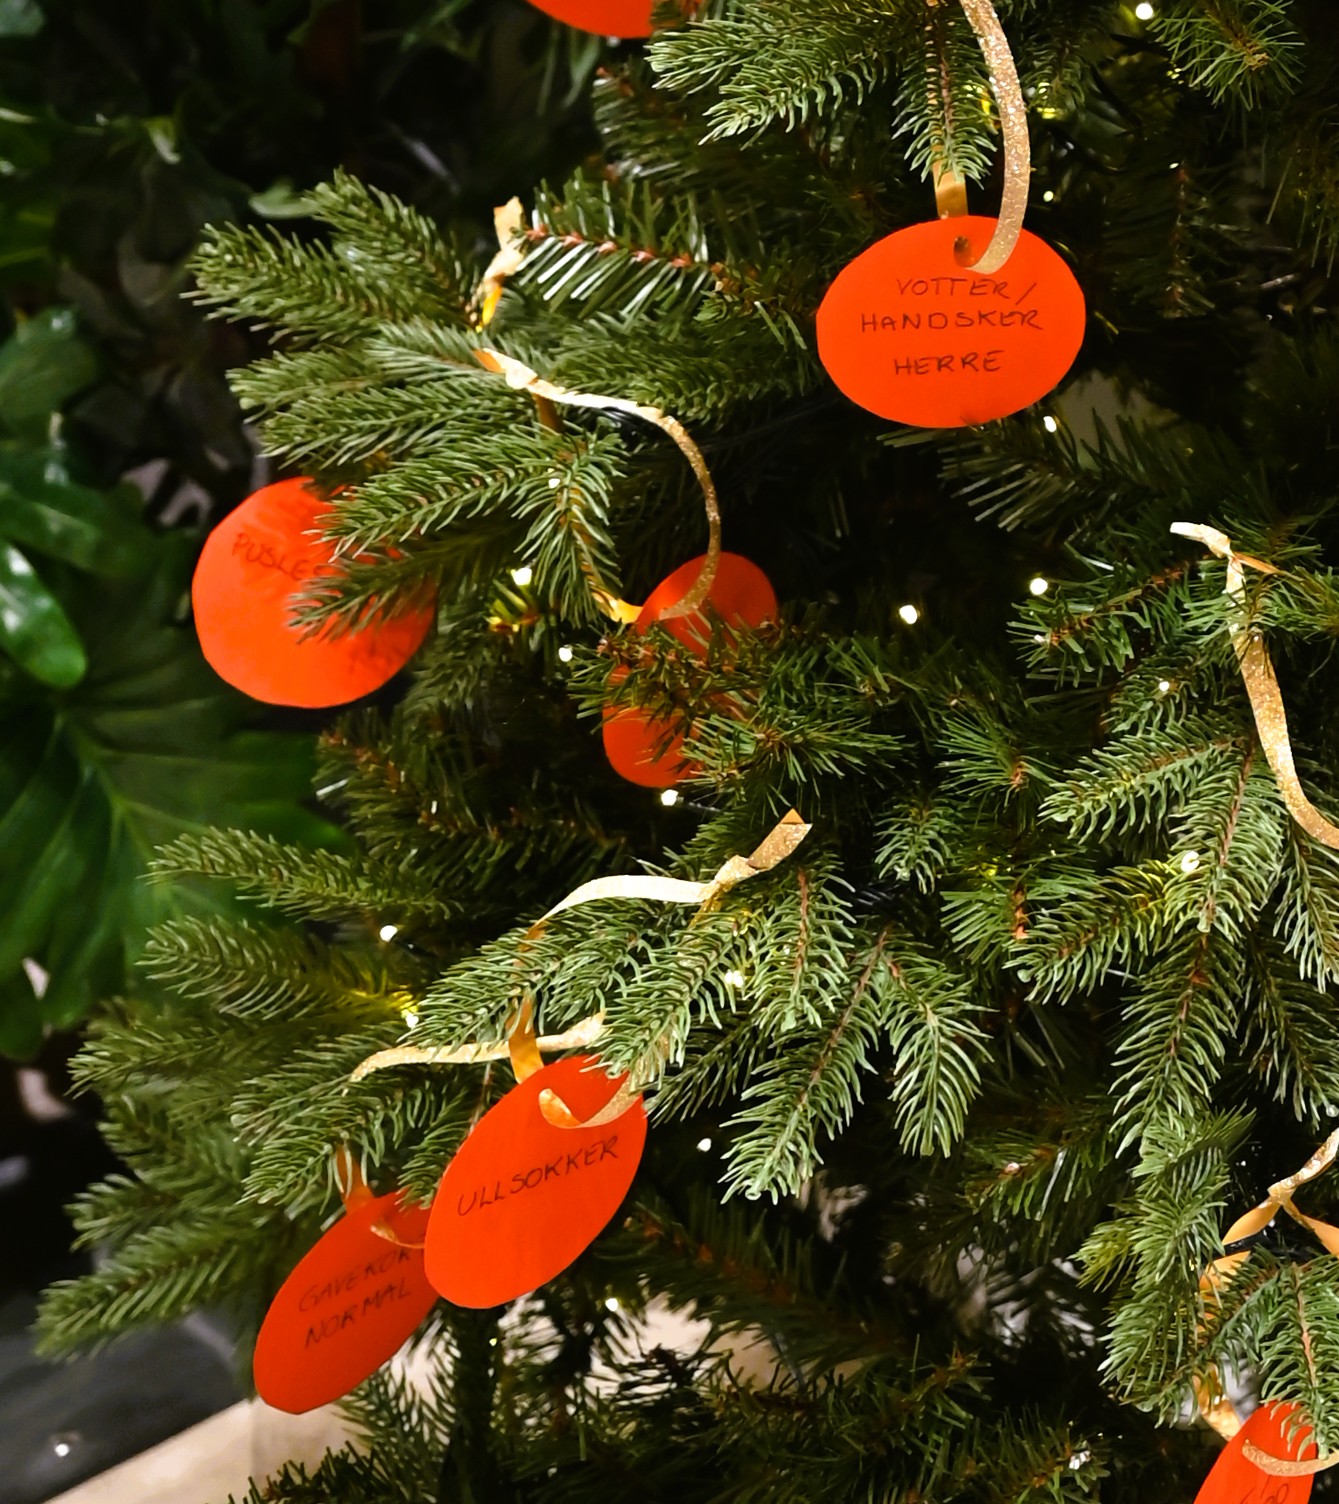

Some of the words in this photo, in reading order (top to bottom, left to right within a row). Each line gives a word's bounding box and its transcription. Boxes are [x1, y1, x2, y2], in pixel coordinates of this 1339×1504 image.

[861, 309, 1044, 333] HANDSKER
[894, 350, 1005, 376] HERRE
[457, 1135, 620, 1218] ULLSOKKER
[305, 1276, 412, 1350] NORMAL
